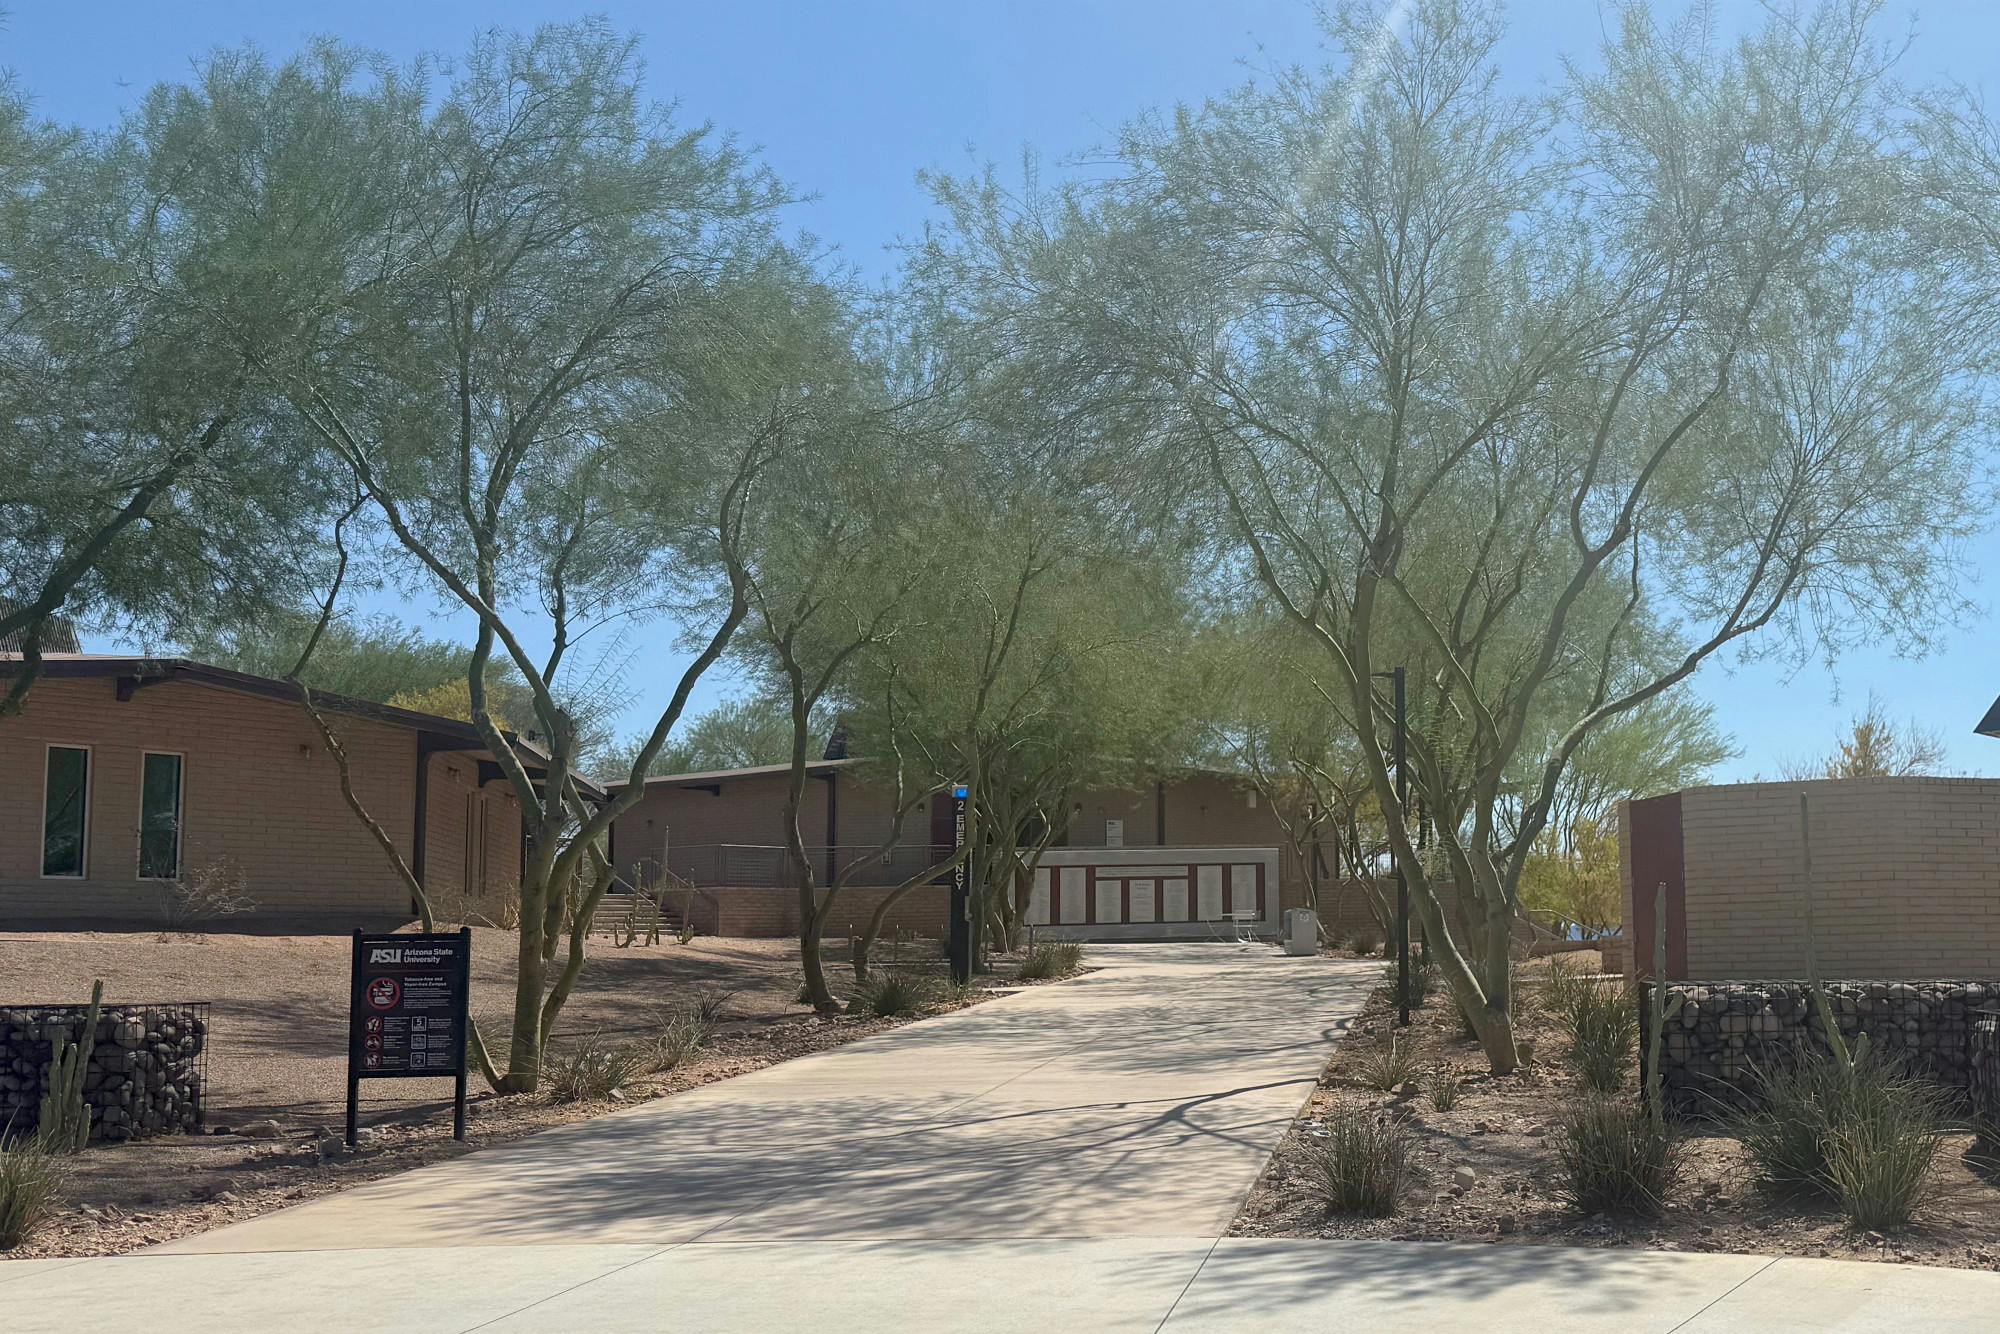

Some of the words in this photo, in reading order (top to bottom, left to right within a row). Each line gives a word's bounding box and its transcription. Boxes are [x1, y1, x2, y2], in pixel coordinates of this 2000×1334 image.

[957, 800, 965, 811] 2
[955, 814, 965, 890] EMERNCY
[369, 948, 402, 964] ASU
[404, 948, 433, 956] Arizona
[433, 948, 453, 956] State
[403, 955, 441, 964] University
